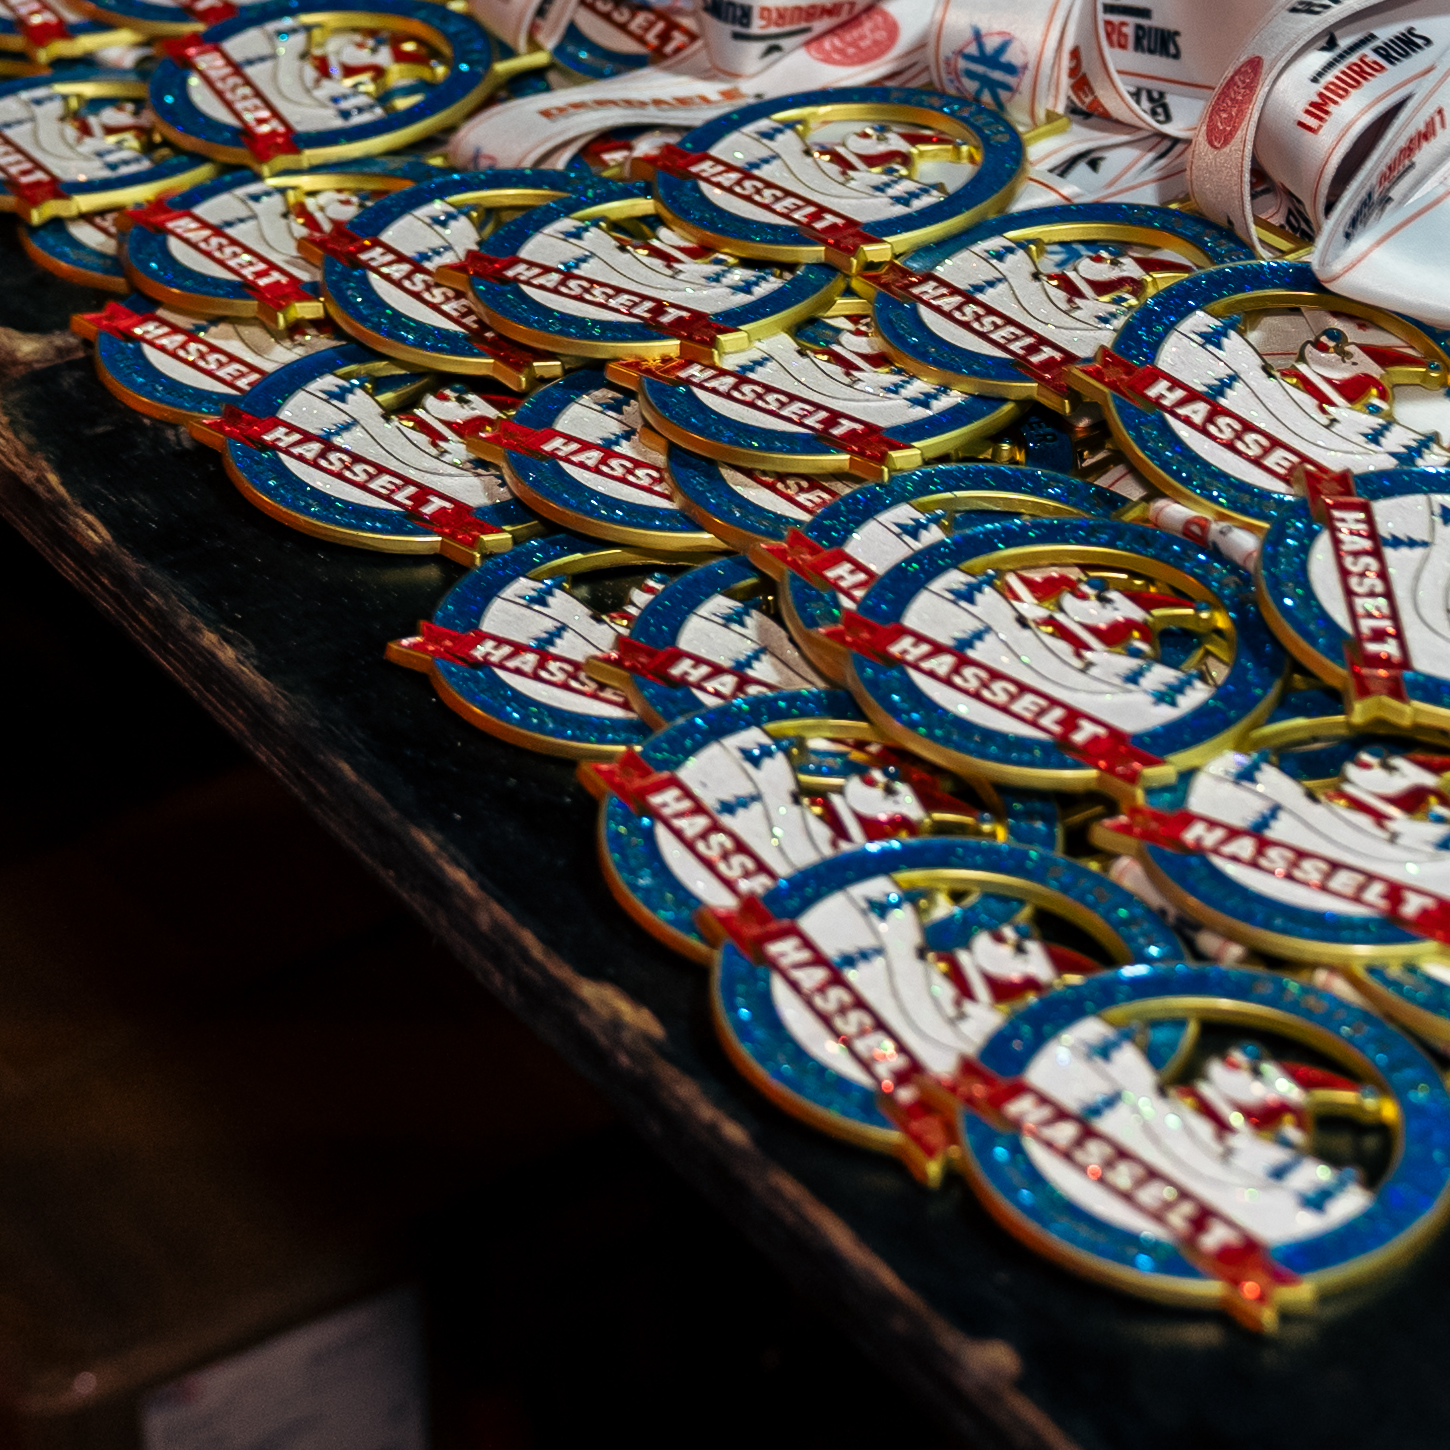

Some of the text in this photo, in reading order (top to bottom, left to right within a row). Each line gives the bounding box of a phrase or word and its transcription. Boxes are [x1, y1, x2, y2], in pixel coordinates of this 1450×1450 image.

[757, 0, 859, 32] LIMBURG
[1133, 28, 1182, 61] RUNS
[1296, 26, 1435, 135] LIMBURG RUNS
[690, 158, 848, 233] HASSELT
[165, 214, 292, 288] HASSELT
[504, 260, 686, 325] HASSELT
[910, 278, 1065, 368] HASSELT
[678, 362, 865, 438] HASSELT
[260, 423, 459, 516] HASSELT
[1332, 508, 1405, 670] HASSELT
[886, 632, 1111, 746] HASSELT
[1180, 819, 1442, 922] HASSELT
[1001, 1089, 1246, 1256] HASSELT
